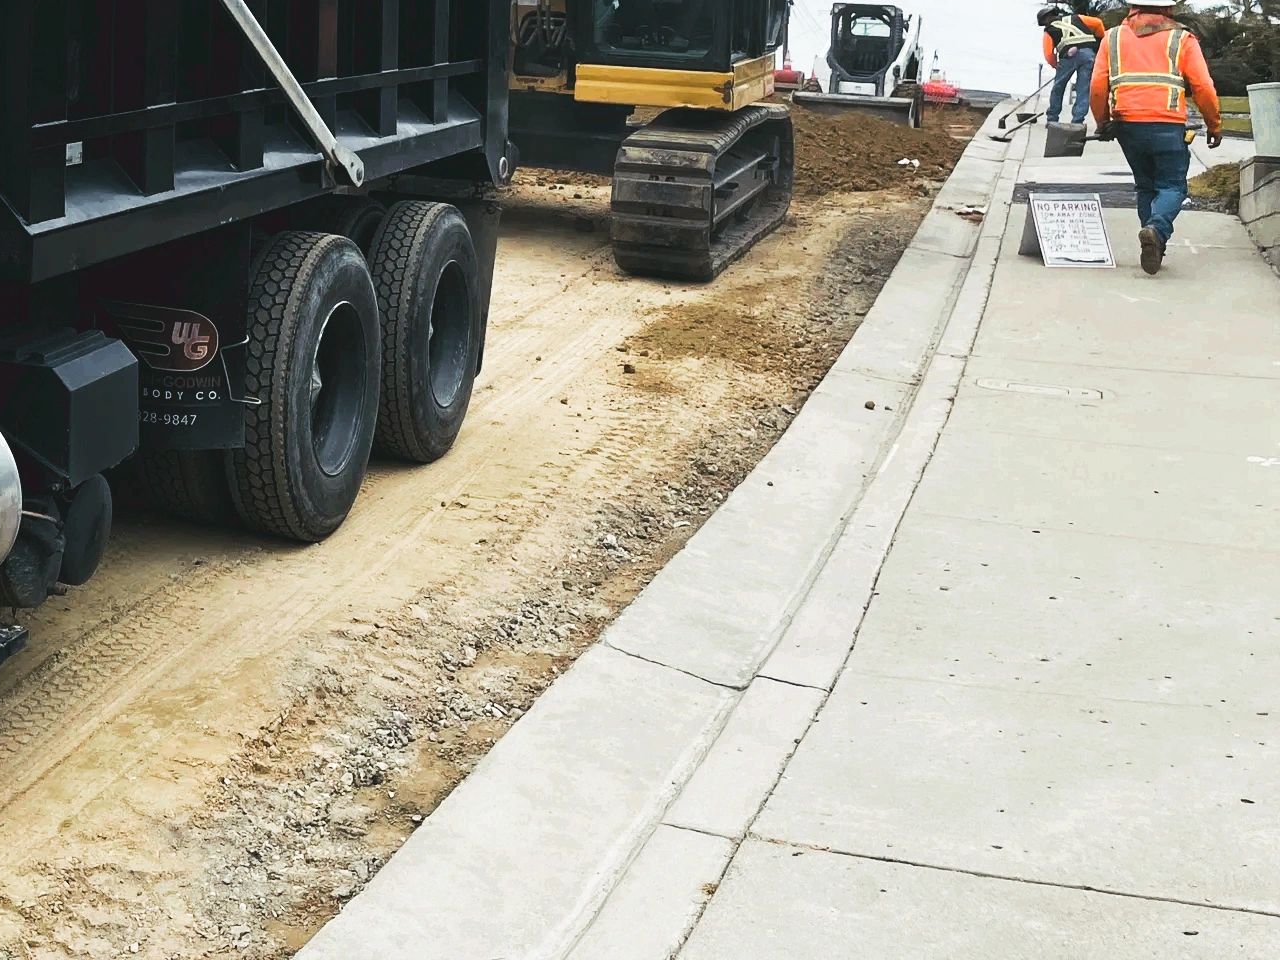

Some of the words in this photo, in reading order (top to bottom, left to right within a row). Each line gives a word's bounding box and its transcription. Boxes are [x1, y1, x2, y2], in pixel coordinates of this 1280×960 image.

[1037, 203, 1051, 212] NO
[1054, 203, 1098, 212] PARKING
[143, 387, 184, 400] BODY
[195, 390, 221, 401] CO.
